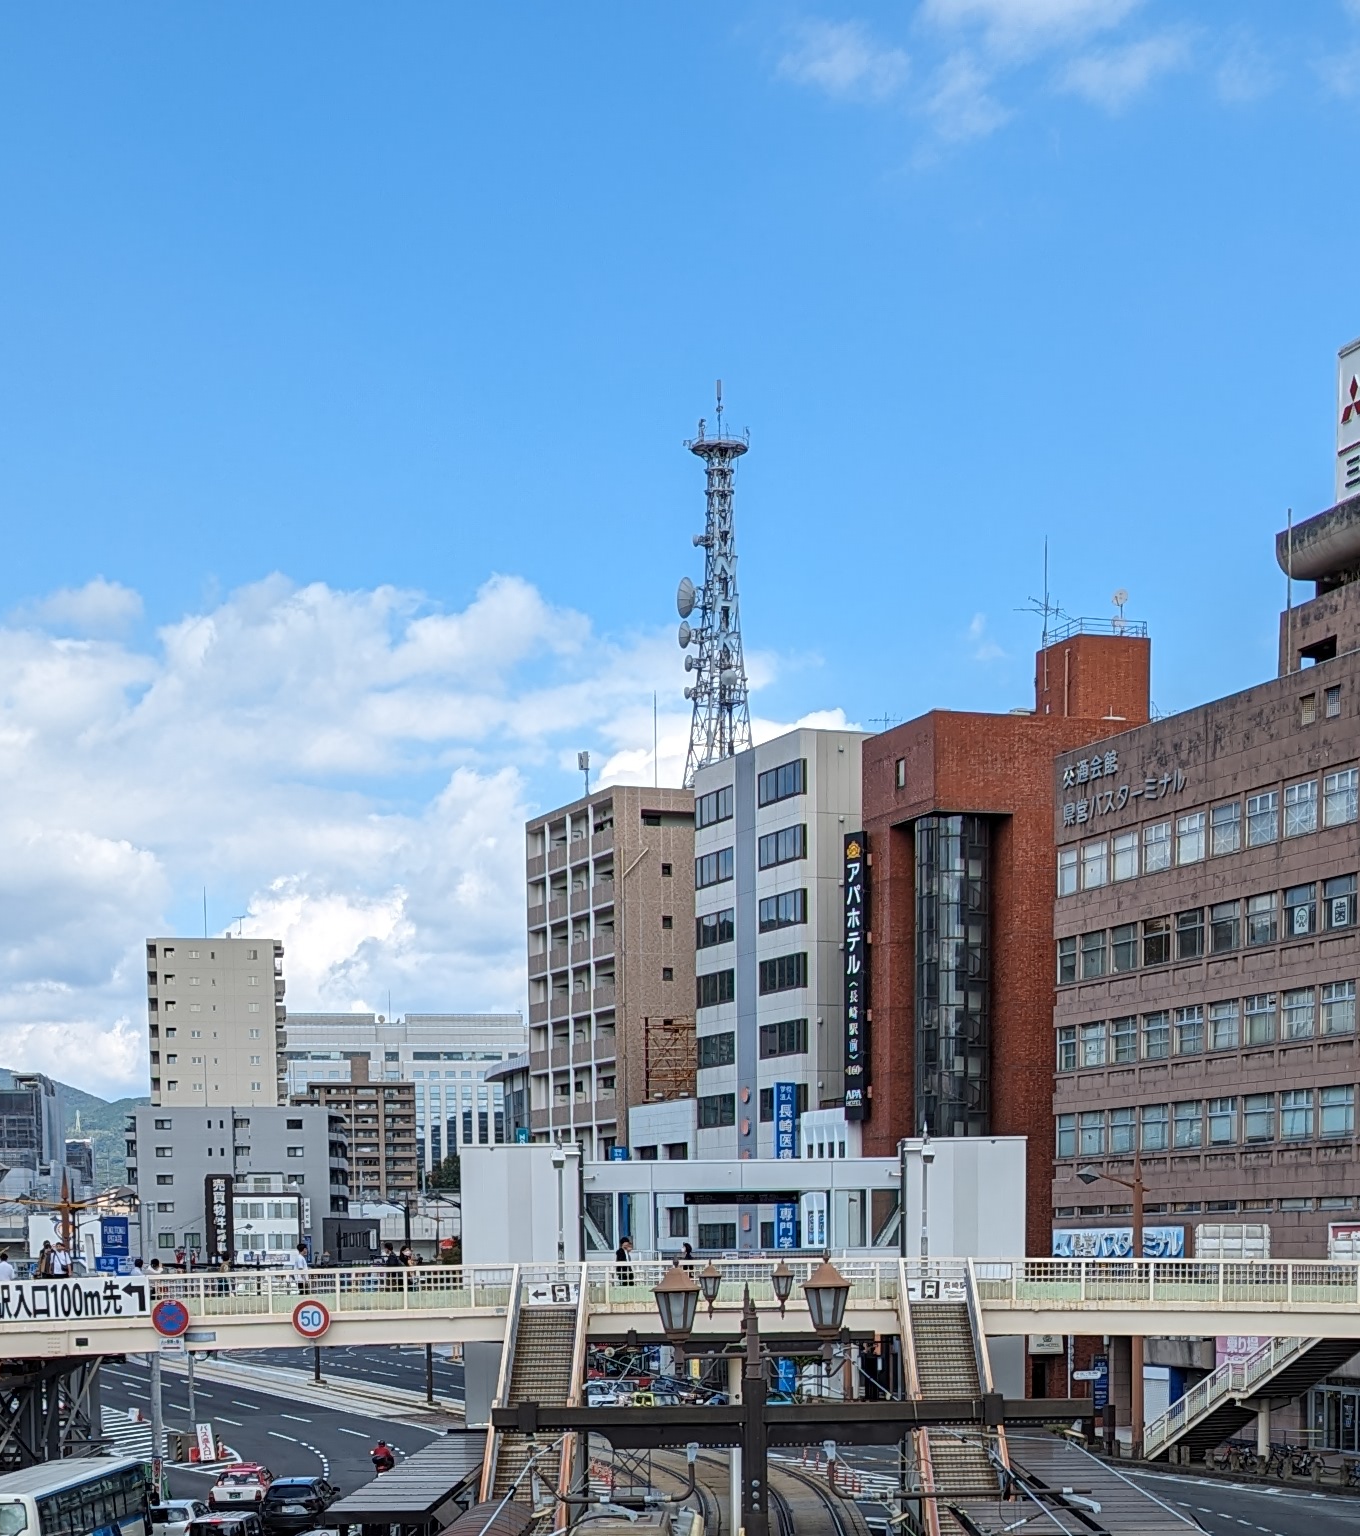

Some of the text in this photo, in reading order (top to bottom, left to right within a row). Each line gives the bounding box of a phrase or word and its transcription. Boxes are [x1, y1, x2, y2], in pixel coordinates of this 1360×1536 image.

[1063, 750, 1118, 790] 交通会館
[1063, 768, 1188, 828] 県営バスターミナル
[846, 862, 861, 975] アパホテル
[300, 1310, 322, 1328] 50
